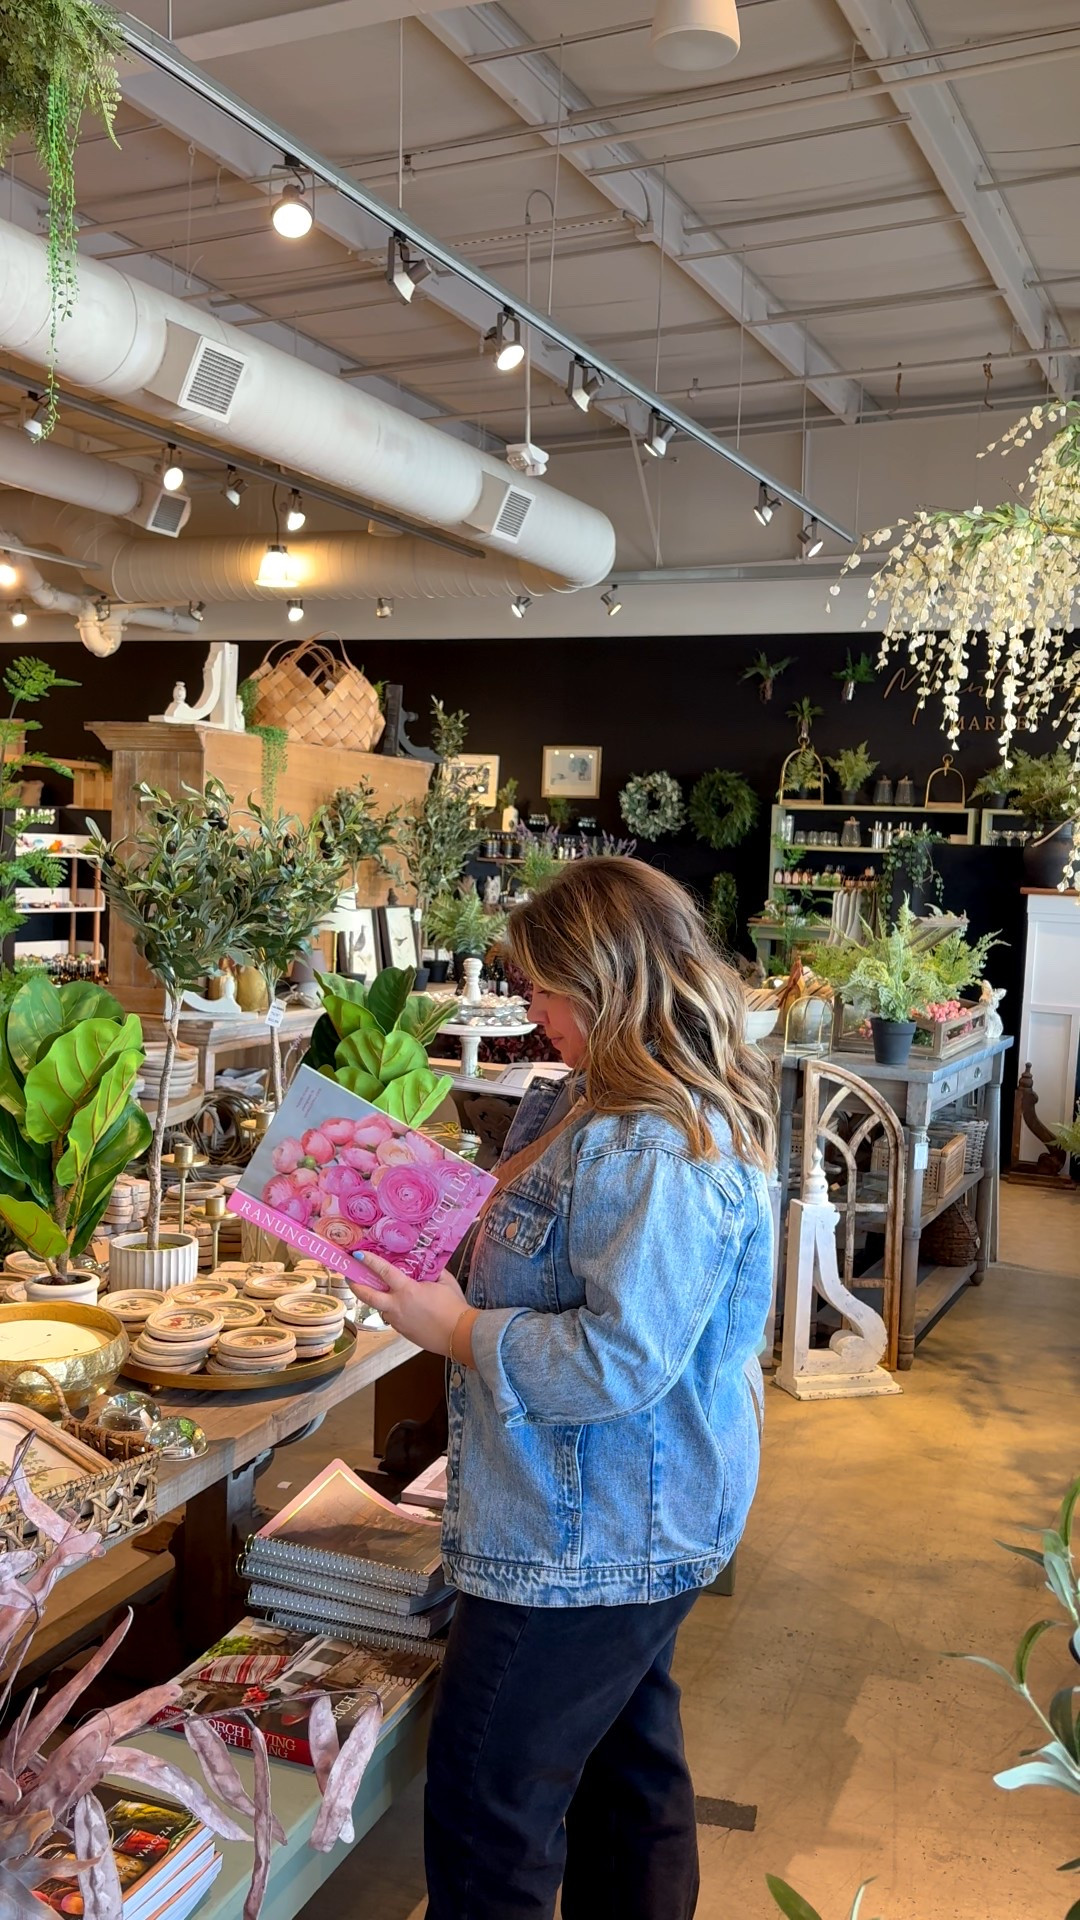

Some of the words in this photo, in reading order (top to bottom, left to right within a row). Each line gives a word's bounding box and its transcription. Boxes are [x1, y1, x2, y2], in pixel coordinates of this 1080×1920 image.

[240, 1201, 350, 1271] RANUNCULUS
[207, 1719, 246, 1738] ORCH
[136, 1826, 174, 1857] VAROZZA
